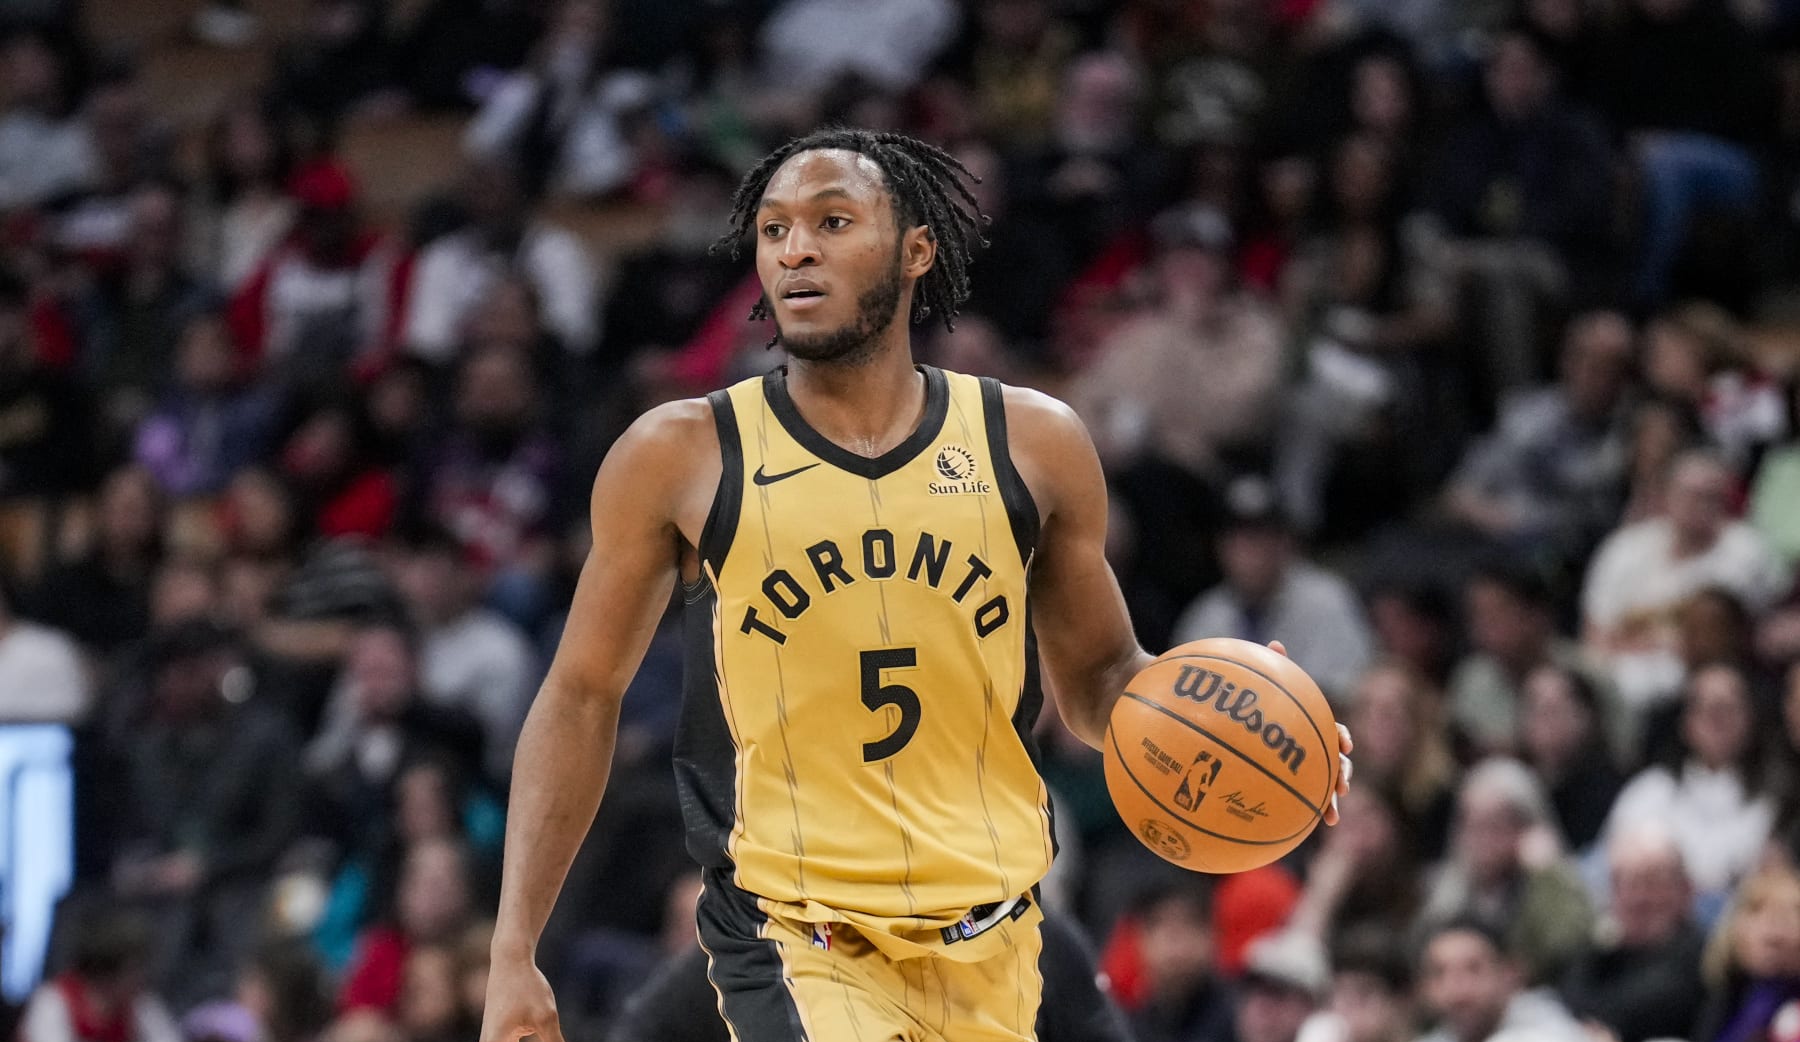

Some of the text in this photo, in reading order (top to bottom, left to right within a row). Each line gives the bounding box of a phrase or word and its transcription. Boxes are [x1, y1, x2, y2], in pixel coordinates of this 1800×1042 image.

[929, 480, 991, 495] Sun Life
[740, 528, 1010, 647] TORONTO
[859, 647, 922, 763] 5
[1173, 664, 1307, 775] Wilson
